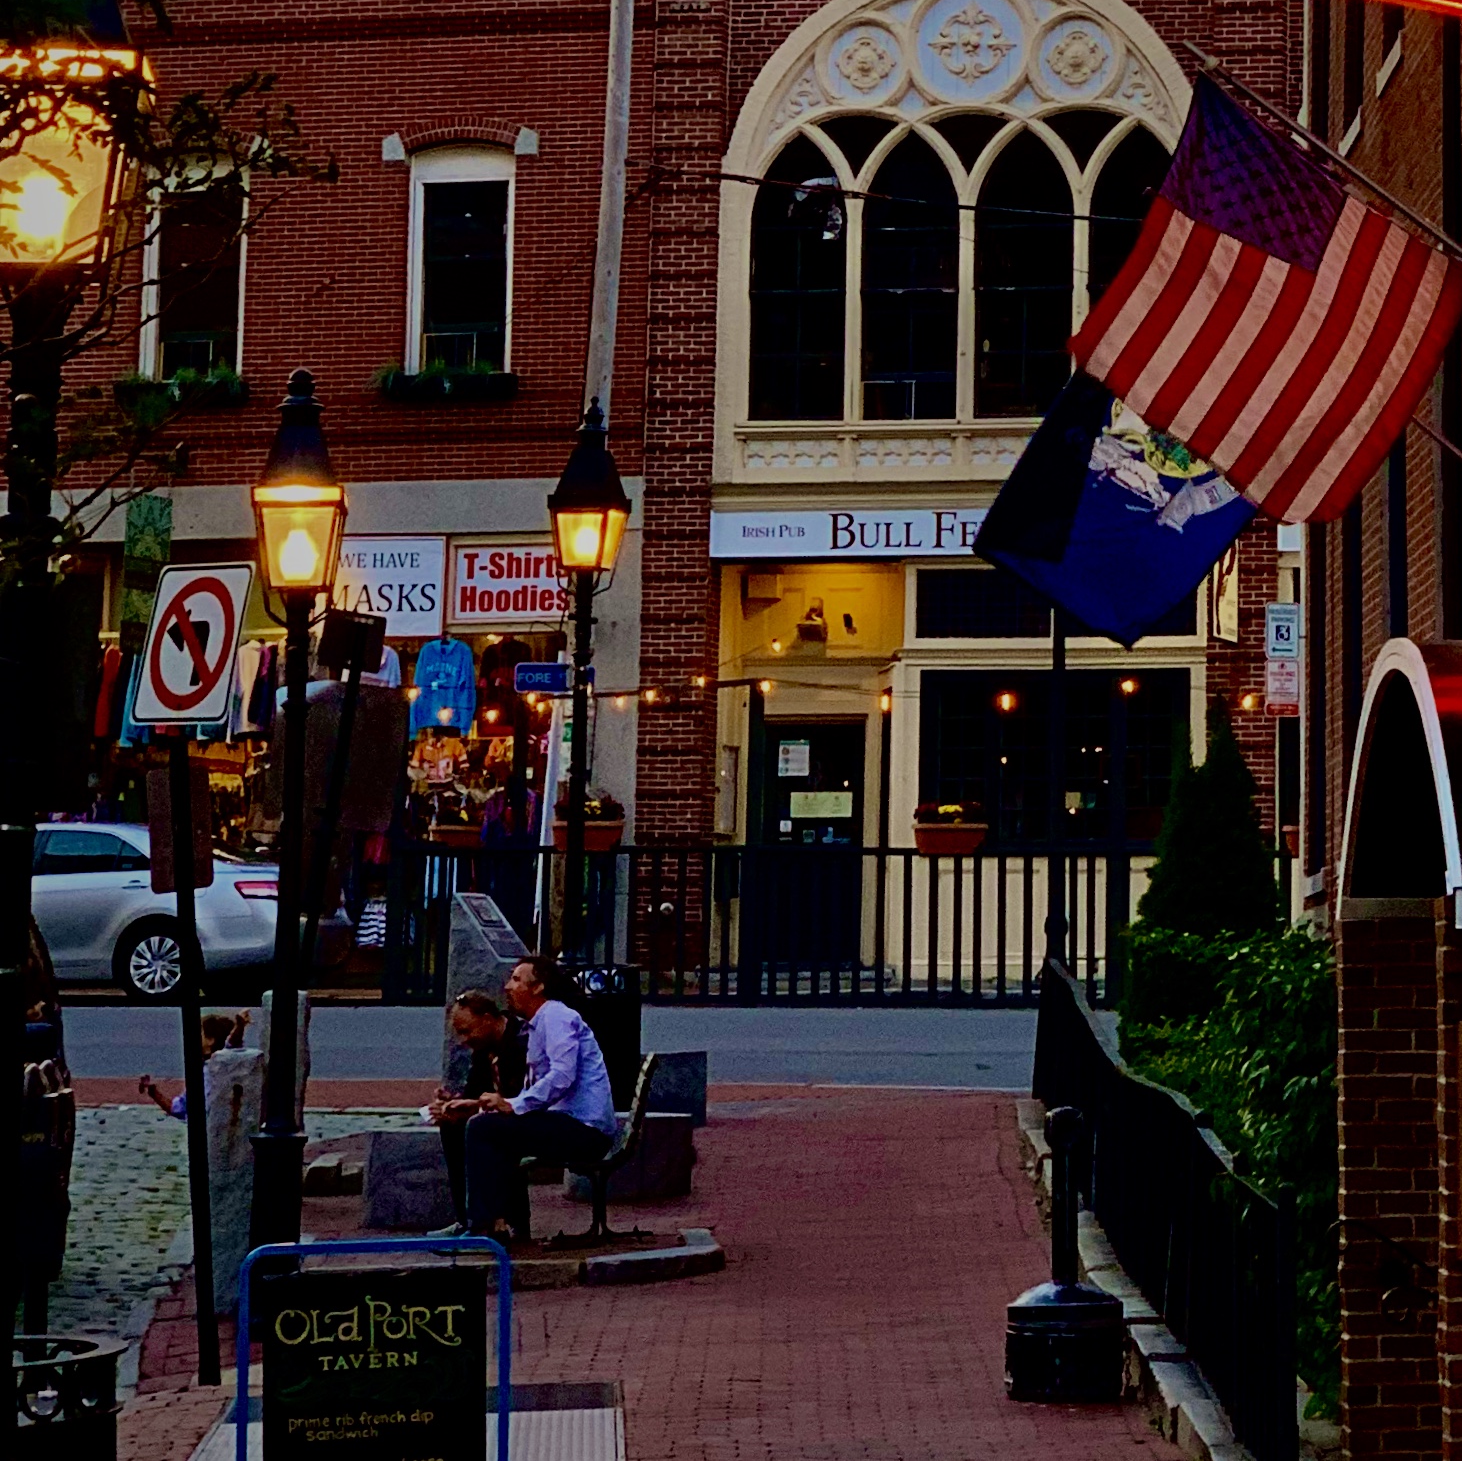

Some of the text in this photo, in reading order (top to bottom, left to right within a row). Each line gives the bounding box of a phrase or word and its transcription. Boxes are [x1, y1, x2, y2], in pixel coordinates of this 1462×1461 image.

[829, 512, 922, 550] BULL
[932, 511, 984, 548] FE
[337, 551, 421, 568] WE HAVE
[463, 552, 568, 580] T-Shirt
[459, 585, 570, 613] Hoodies
[517, 672, 552, 684] FORE
[318, 1351, 418, 1371] TAVERN
[288, 1409, 434, 1433] prime rib french dip
[306, 1427, 379, 1442] sandwich
